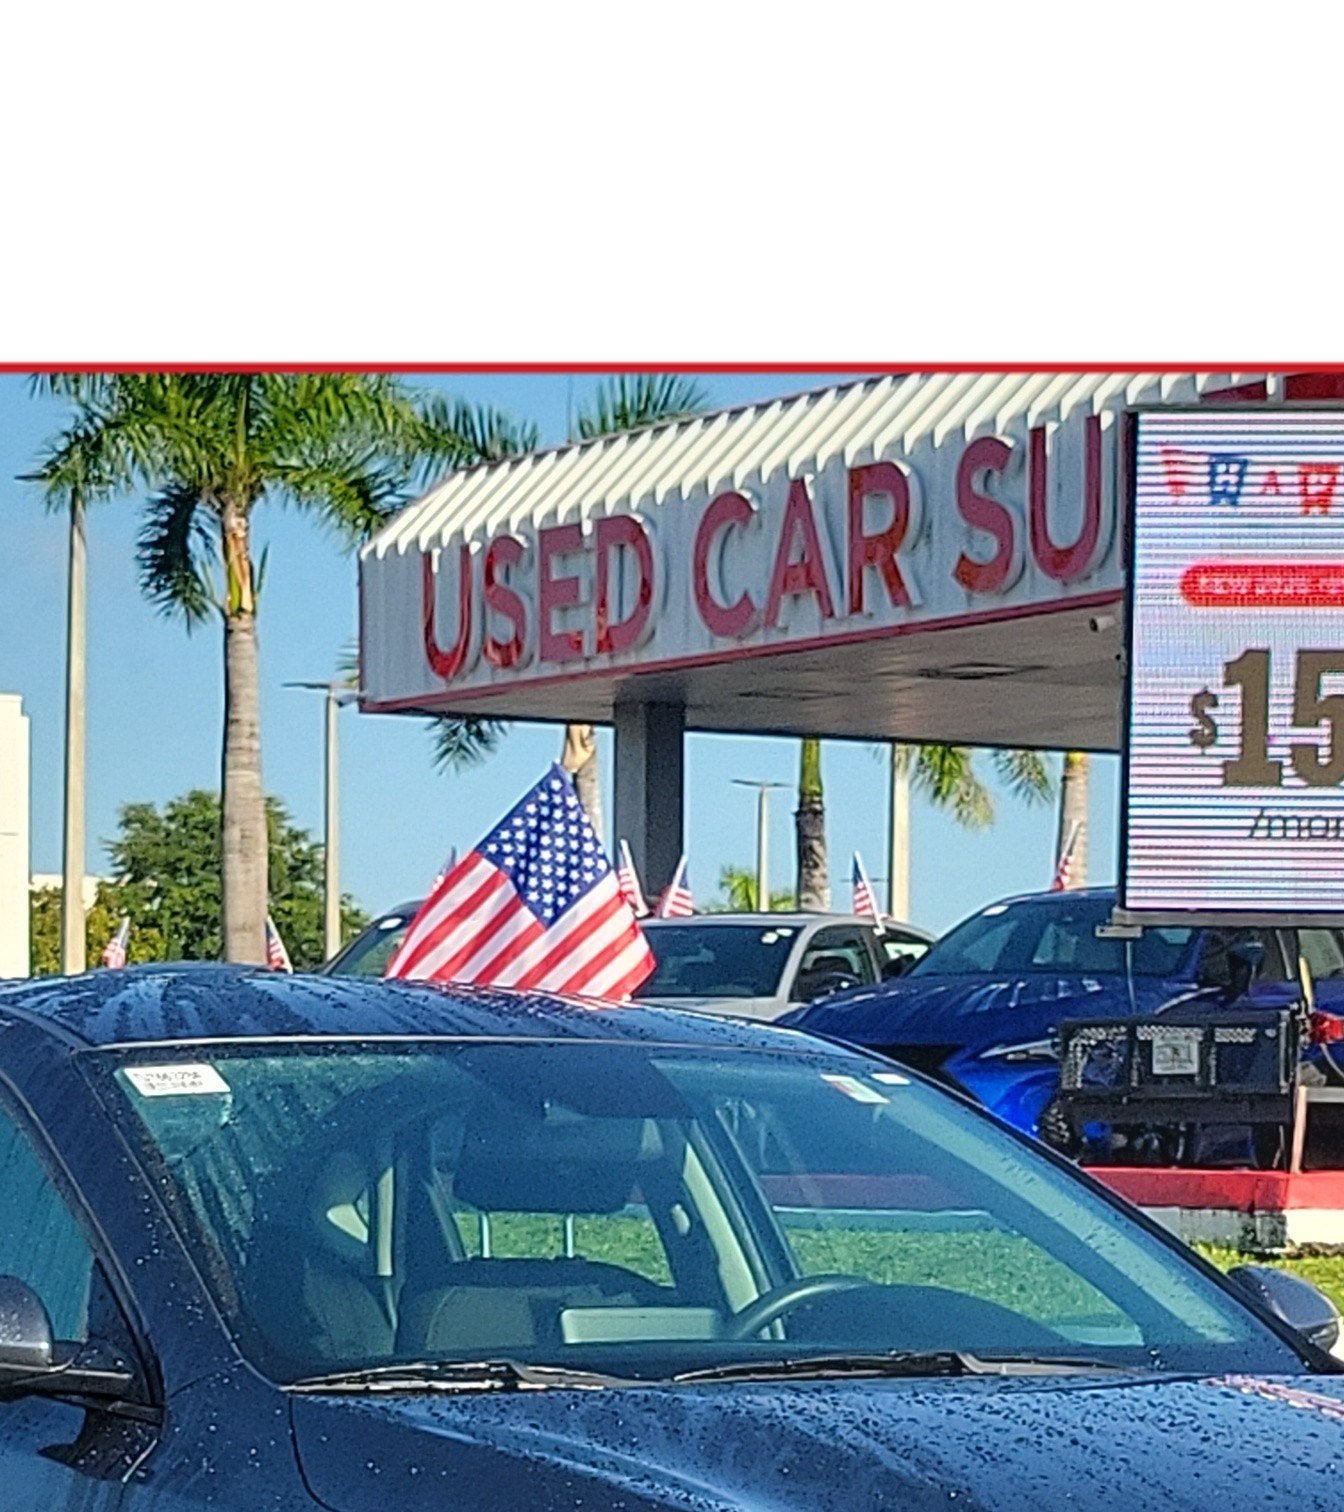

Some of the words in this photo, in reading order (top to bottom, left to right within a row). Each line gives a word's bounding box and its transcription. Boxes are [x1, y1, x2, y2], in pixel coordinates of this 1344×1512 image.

[420, 513, 655, 680] USED
[693, 460, 916, 639] CAR
[952, 412, 1127, 596] SU
